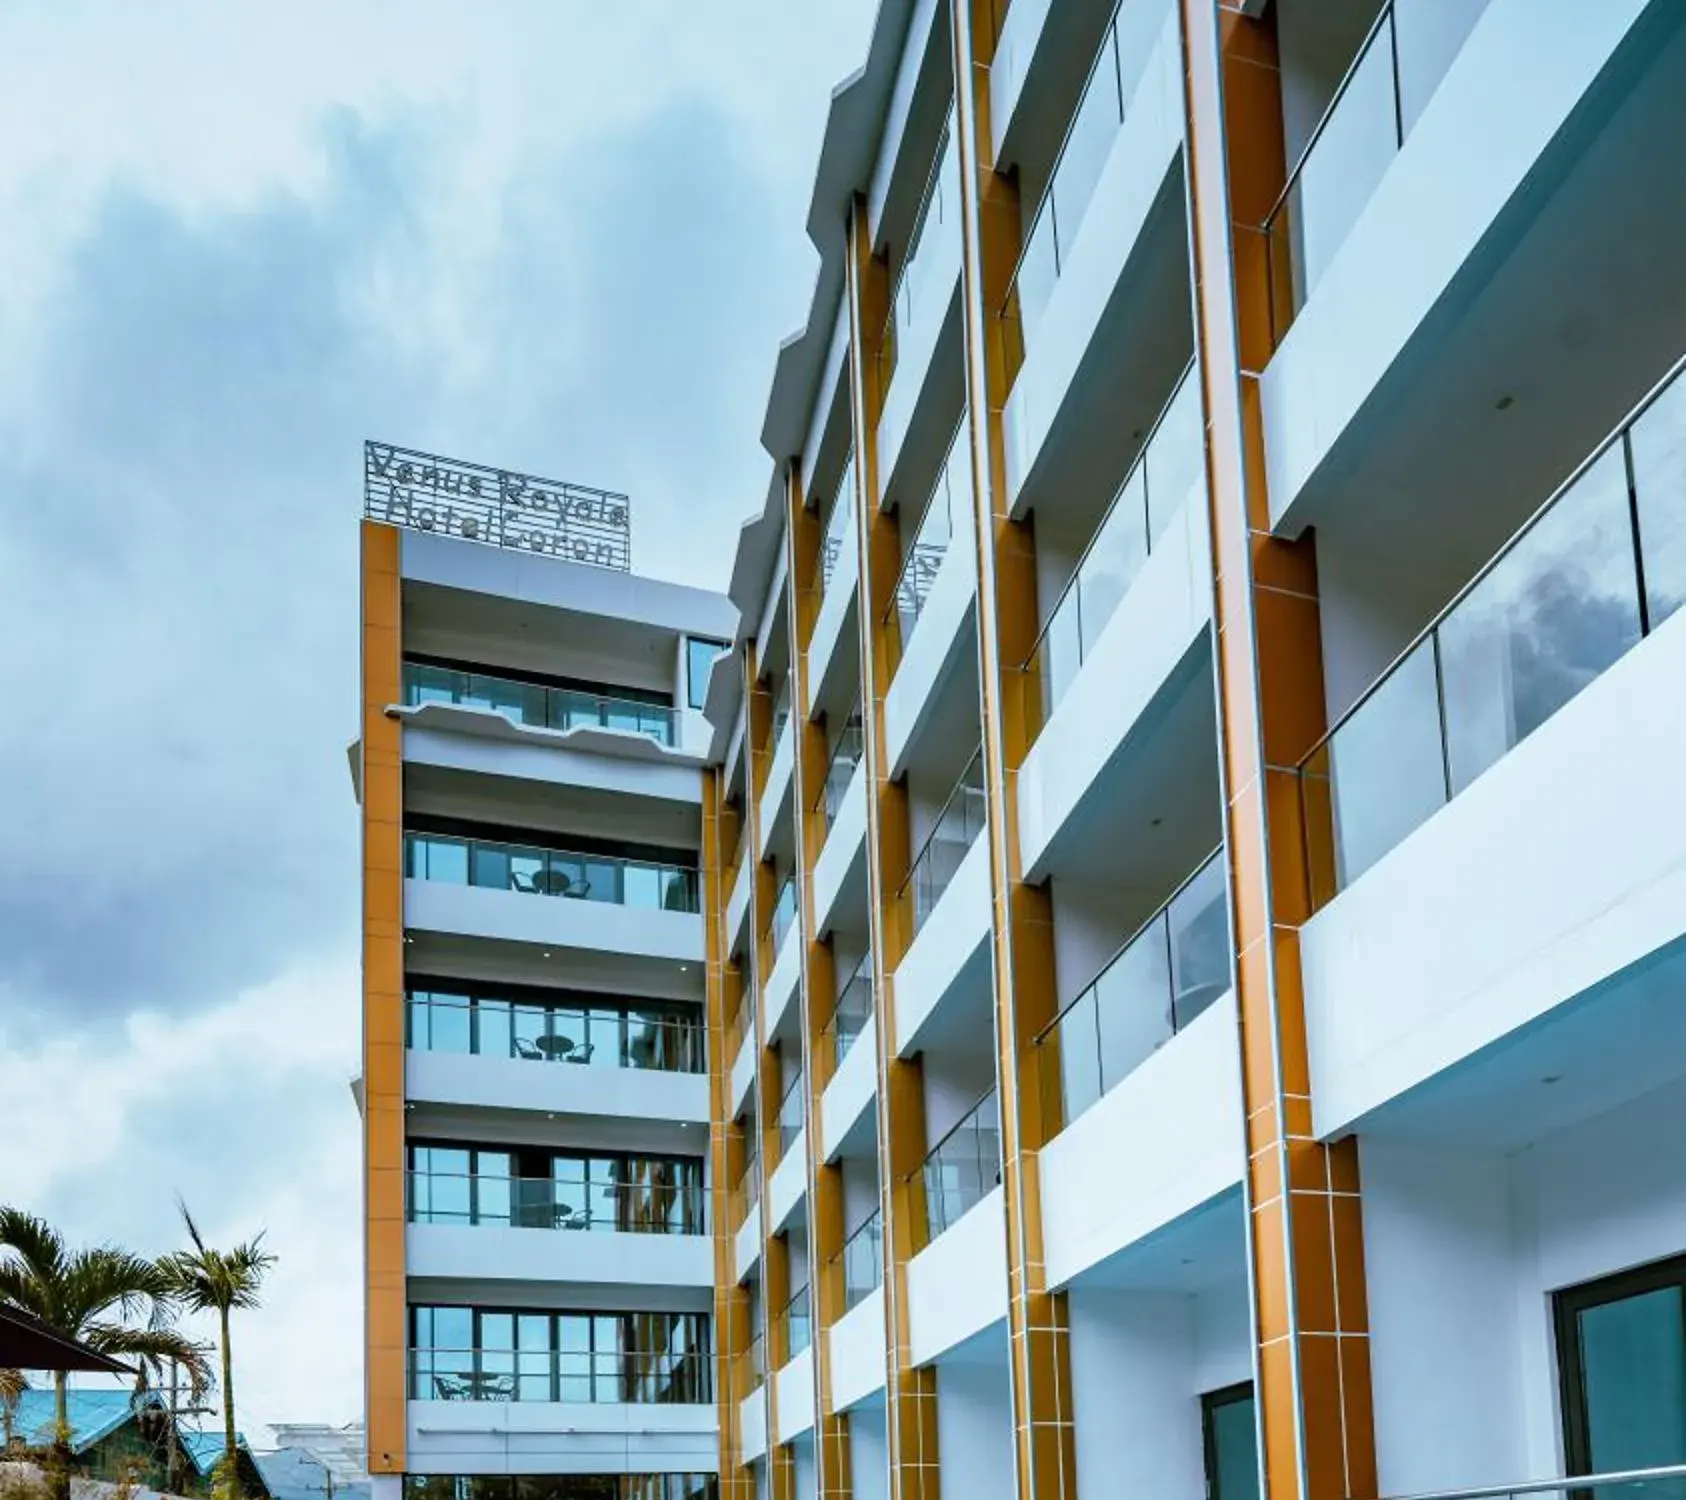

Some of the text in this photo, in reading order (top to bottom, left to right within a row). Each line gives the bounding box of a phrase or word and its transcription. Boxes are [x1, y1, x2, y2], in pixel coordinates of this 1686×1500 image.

[368, 445, 626, 530] Venus Royale
[386, 485, 494, 542] Hotel
